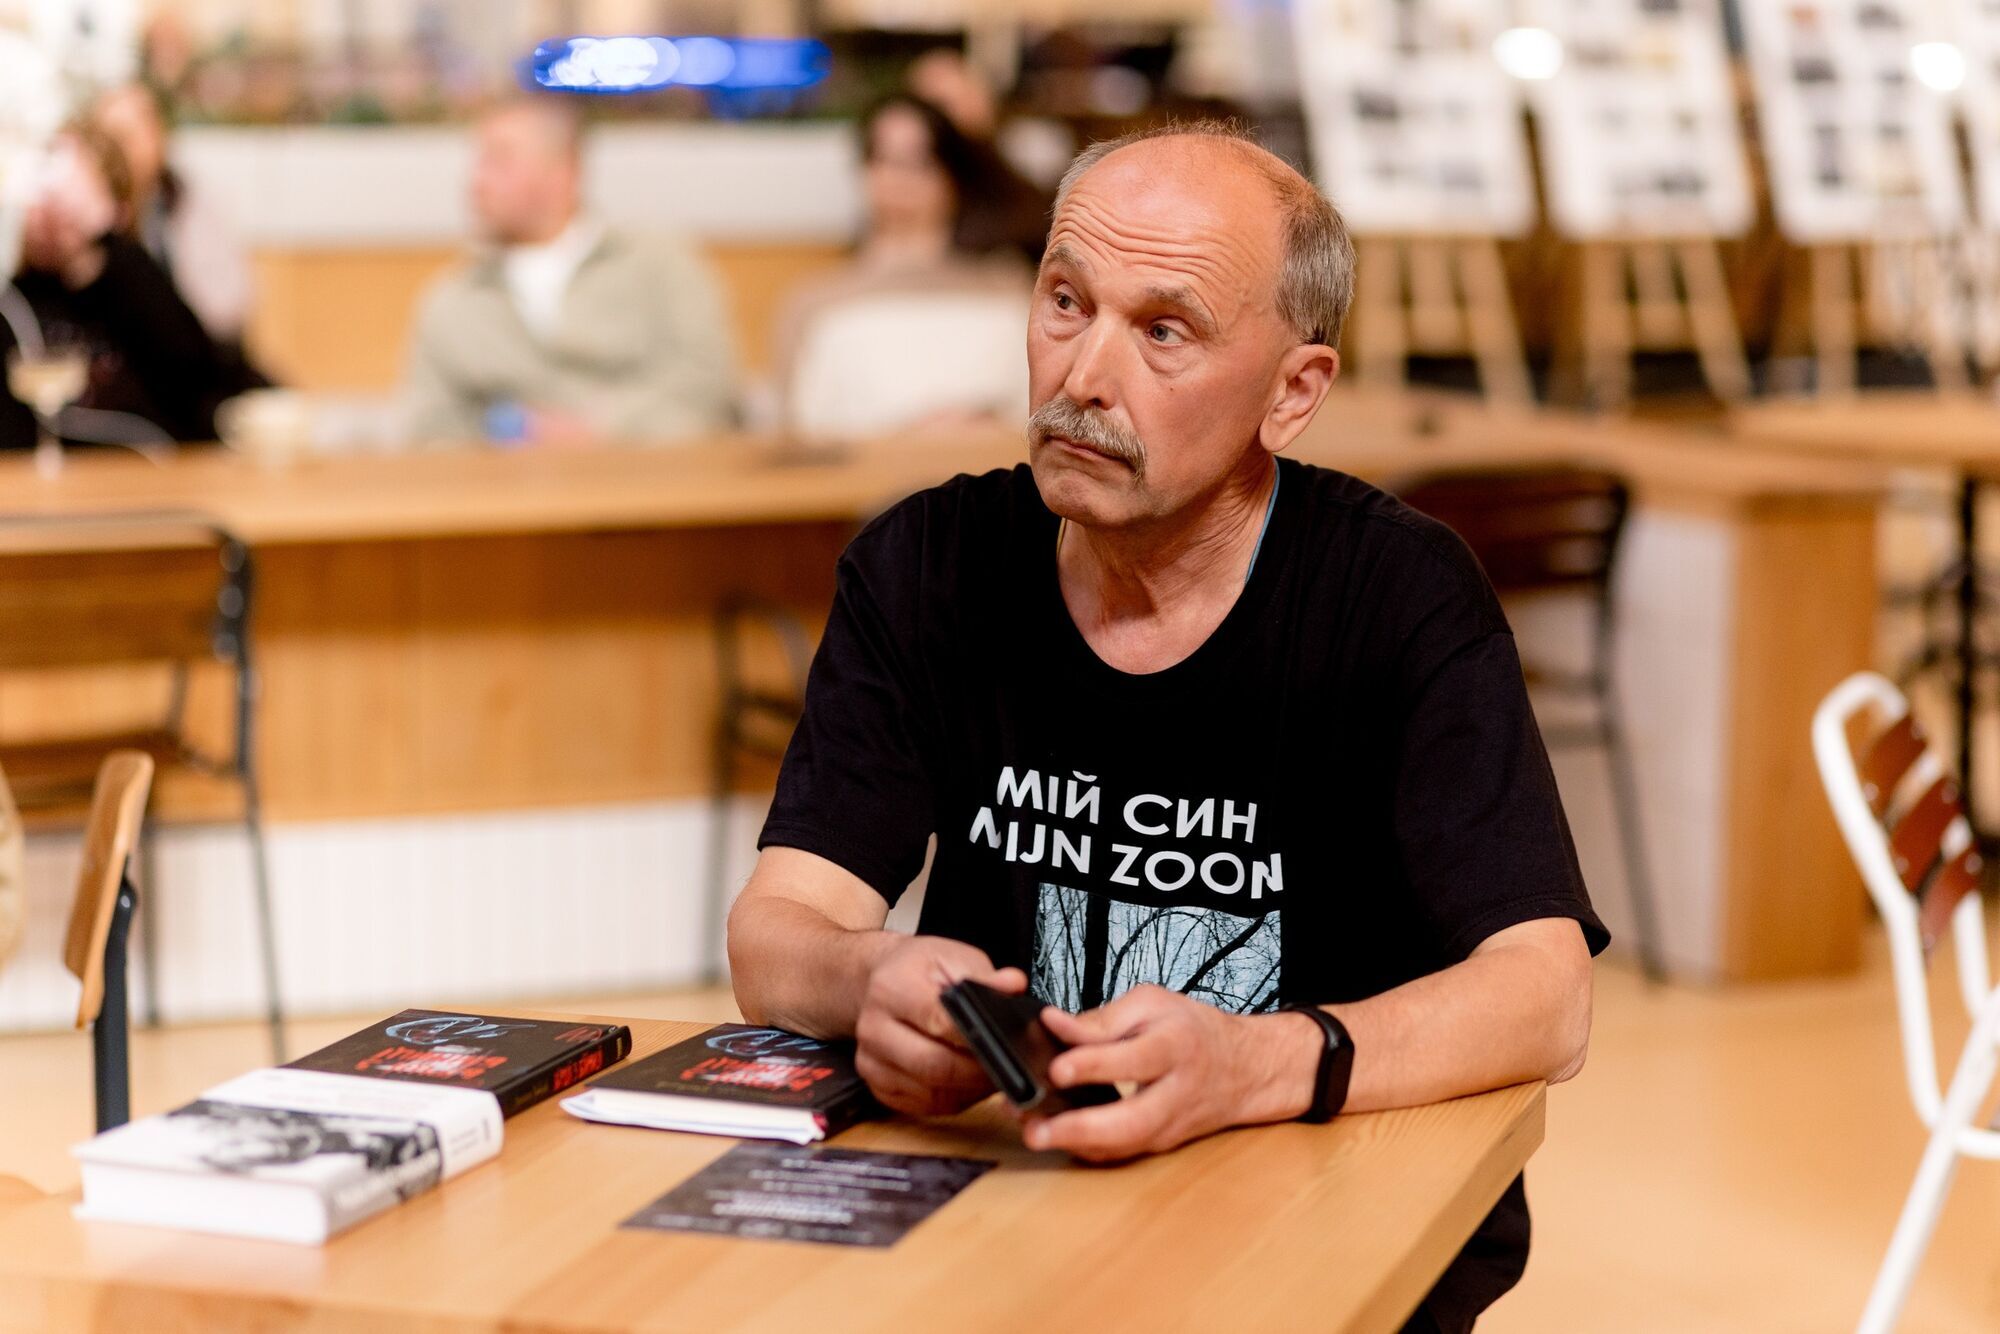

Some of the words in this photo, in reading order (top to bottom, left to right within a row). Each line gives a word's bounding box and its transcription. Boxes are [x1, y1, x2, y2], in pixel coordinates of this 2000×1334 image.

[996, 766, 1101, 825] МІЙ
[1122, 793, 1258, 843] СИН
[1109, 843, 1285, 899] ZOON
